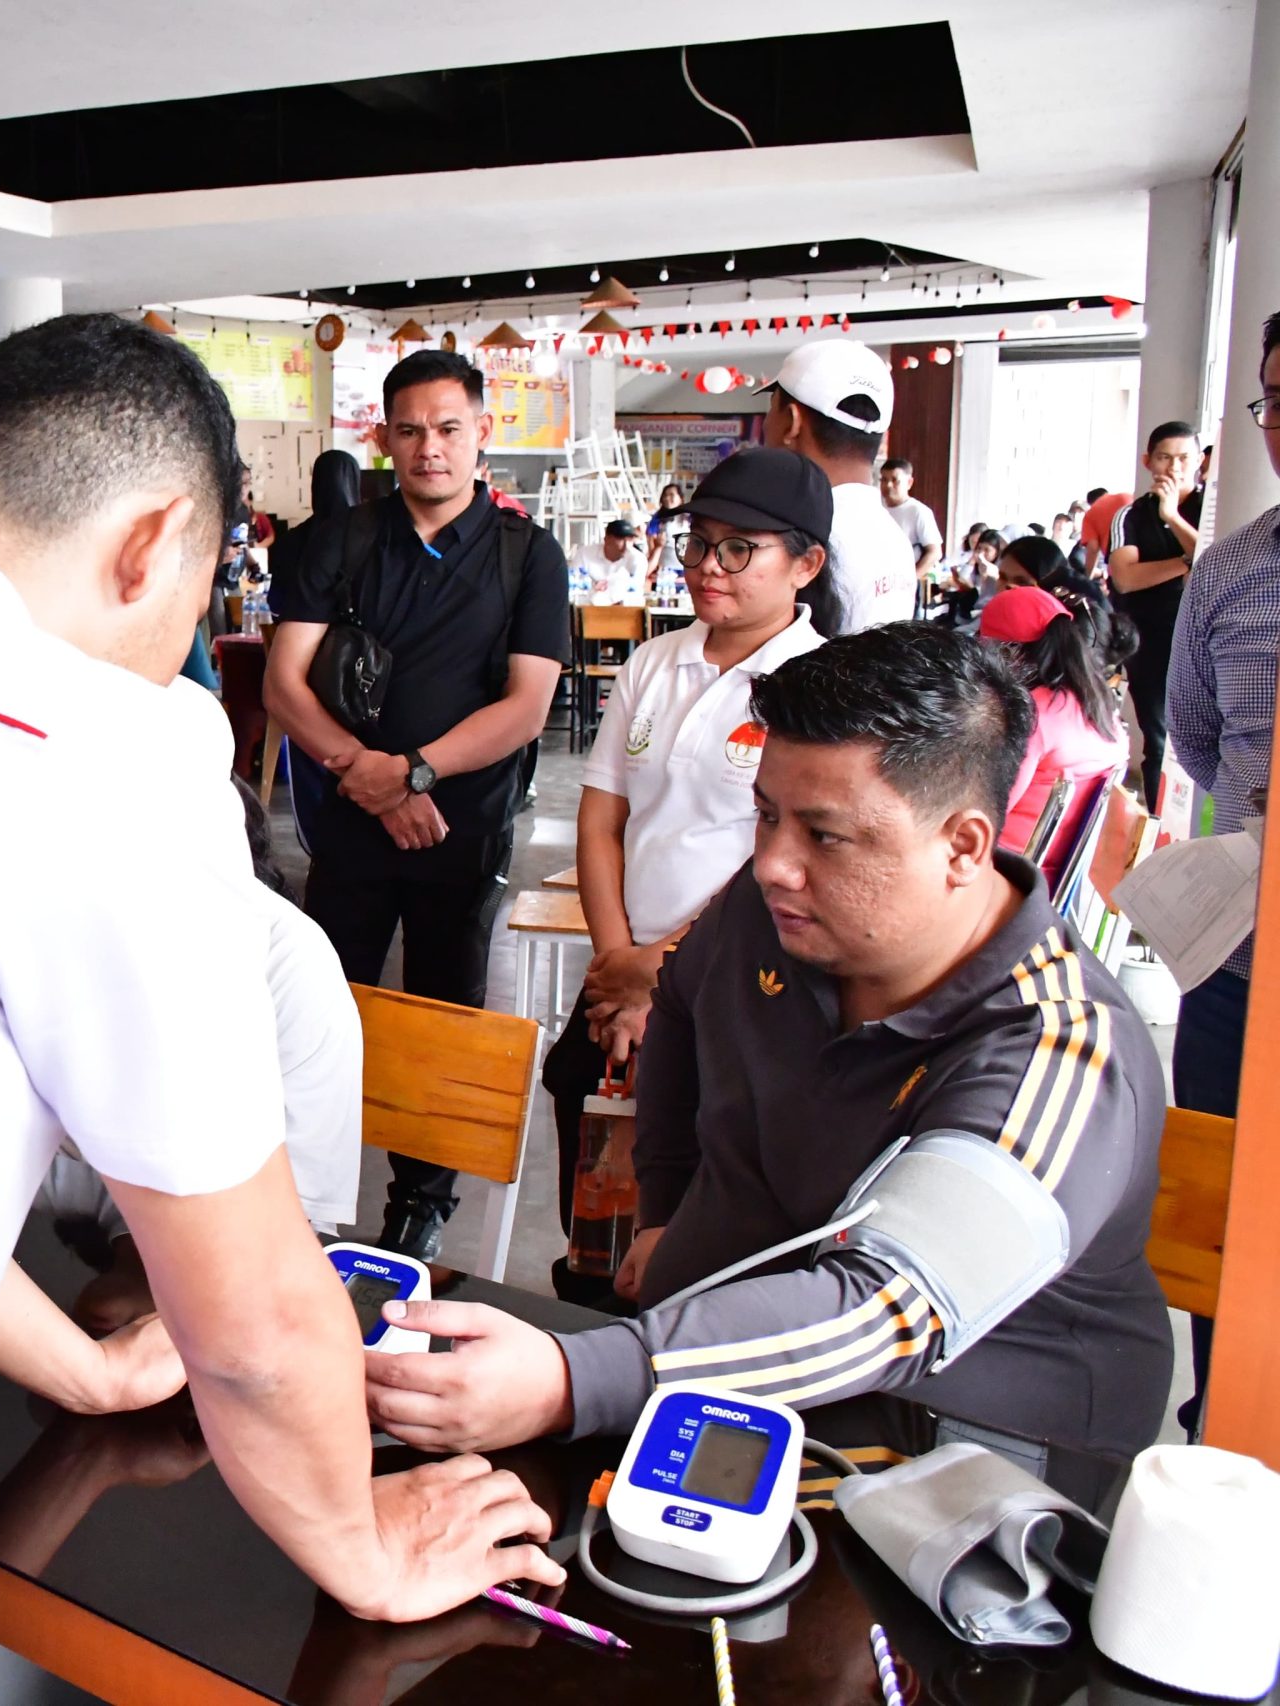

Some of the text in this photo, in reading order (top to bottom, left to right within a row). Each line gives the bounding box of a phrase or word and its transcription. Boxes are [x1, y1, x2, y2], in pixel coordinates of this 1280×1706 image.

[687, 422, 736, 434] CORNER
[353, 1260, 390, 1275] OMRON
[701, 1405, 751, 1423] OMRON
[678, 1428, 694, 1437] SYS
[670, 1450, 686, 1460] DIA
[652, 1468, 678, 1480] PULSE
[676, 1509, 700, 1519] START
[675, 1518, 695, 1527] STOP
